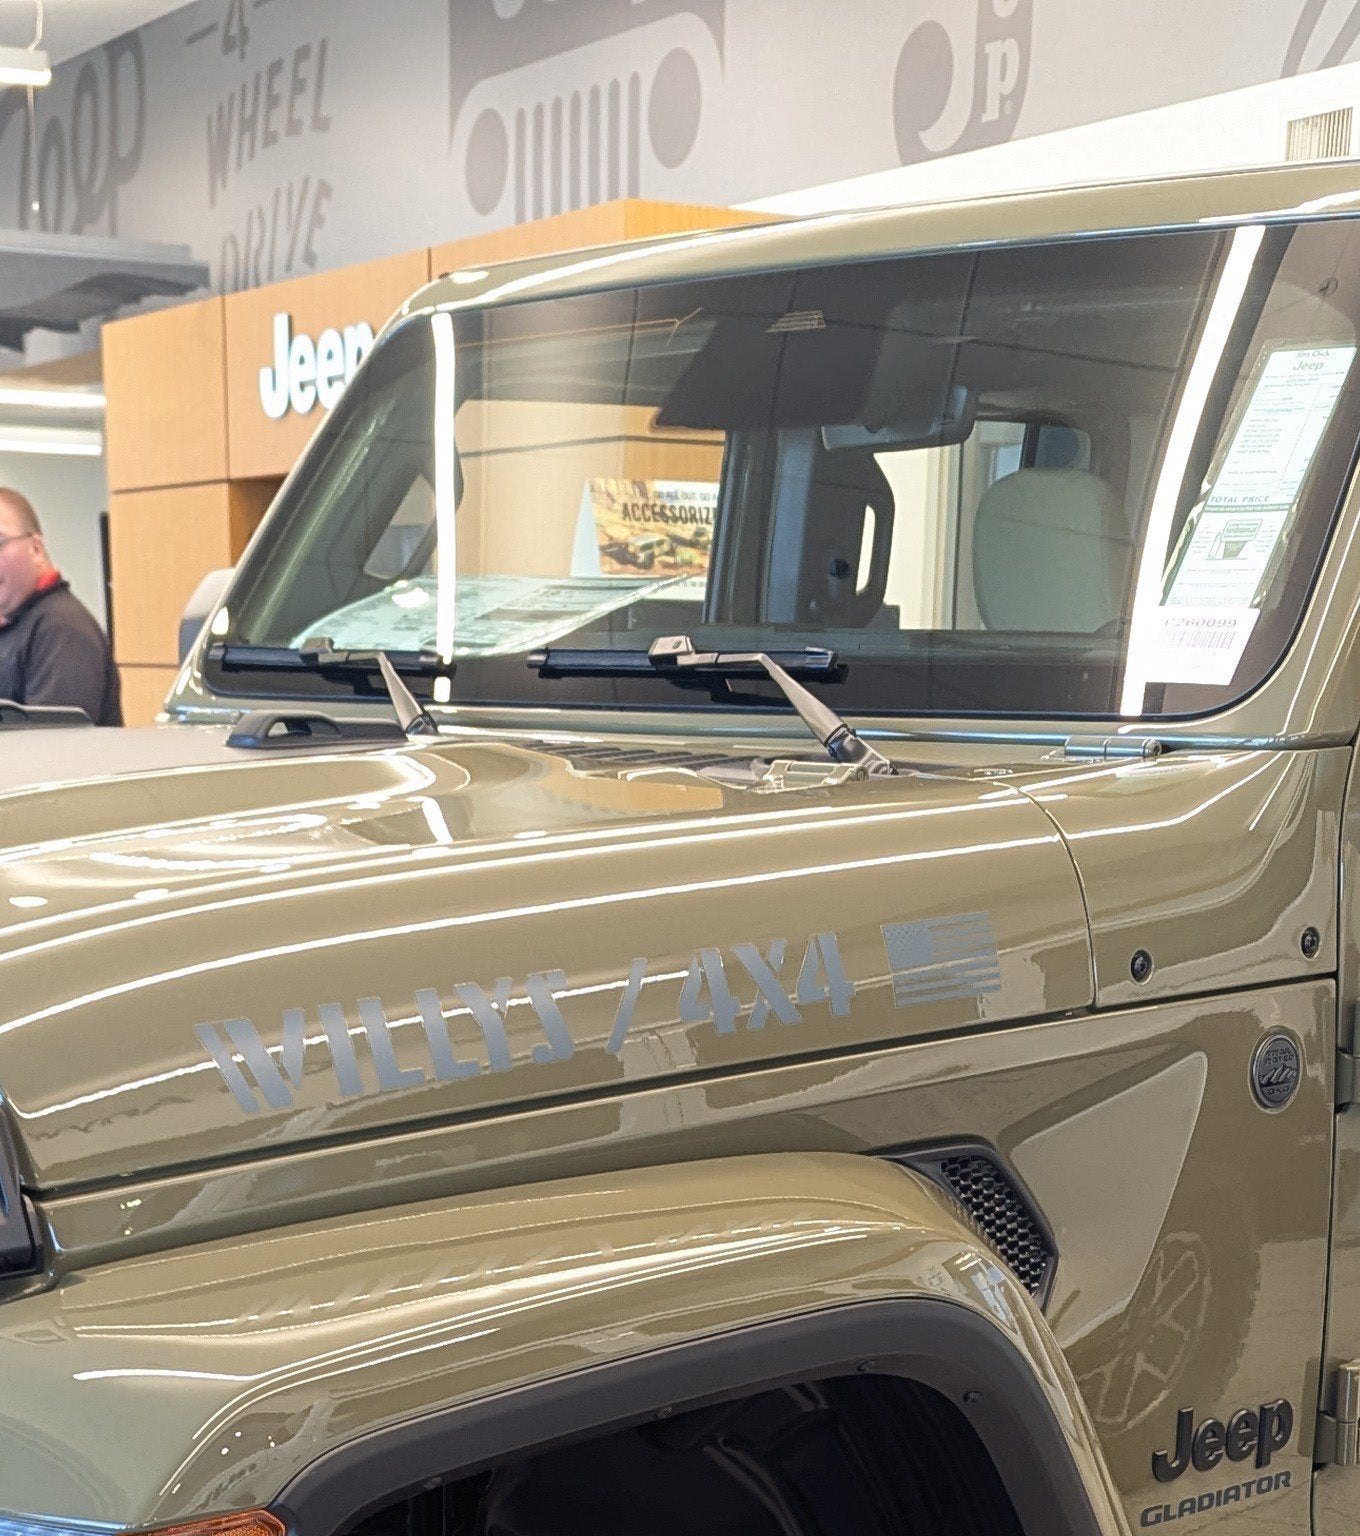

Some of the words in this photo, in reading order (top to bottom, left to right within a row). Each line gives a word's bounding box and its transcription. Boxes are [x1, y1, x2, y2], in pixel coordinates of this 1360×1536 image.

[207, 38, 331, 208] WHEEL
[222, 175, 333, 294] DRIVE
[1293, 360, 1325, 372] Jeep
[1211, 495, 1239, 504] TOTAL
[1242, 494, 1271, 503] PRICE
[194, 968, 574, 1113] WILLYS
[1152, 1398, 1293, 1483] Jeep
[1140, 1470, 1292, 1528] GLADIATOR
